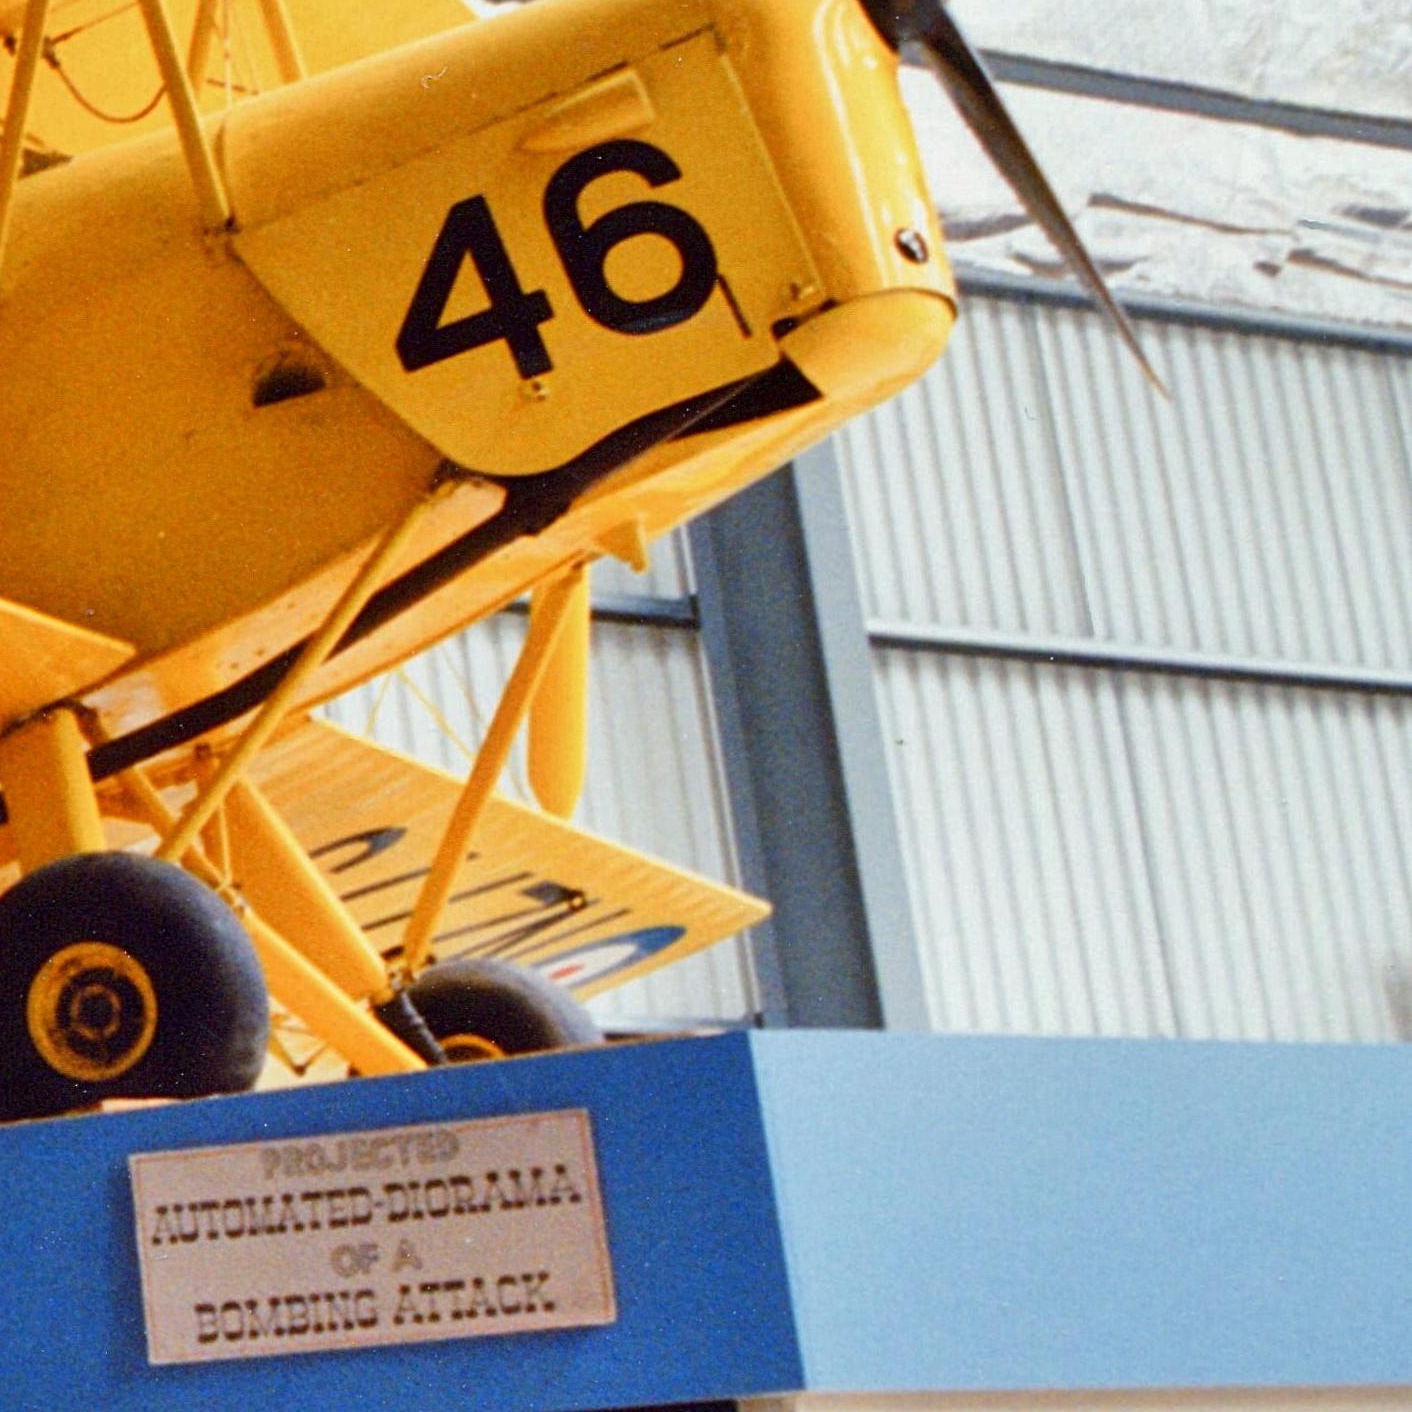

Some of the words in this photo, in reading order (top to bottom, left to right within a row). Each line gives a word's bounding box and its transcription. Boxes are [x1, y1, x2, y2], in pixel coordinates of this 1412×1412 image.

[396, 139, 717, 379] 46
[260, 1127, 460, 1180] PROJECTED
[329, 1243, 380, 1279] OF
[391, 1238, 423, 1273] A
[193, 1288, 378, 1345] BOMBING
[391, 1270, 557, 1327] ATTACK
